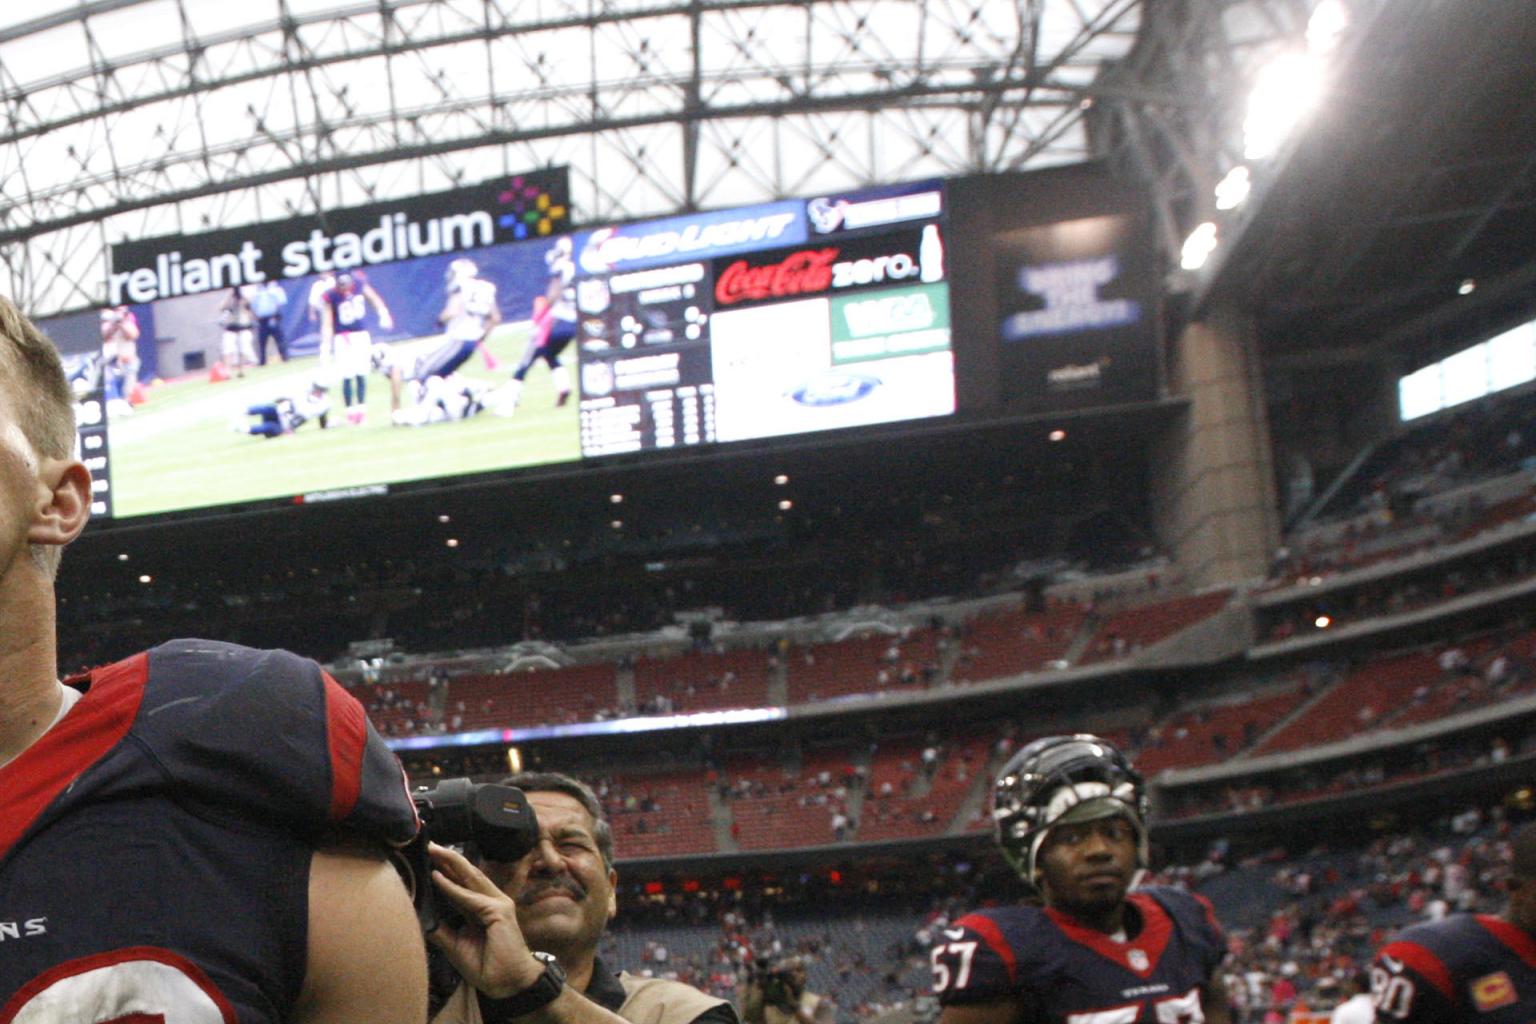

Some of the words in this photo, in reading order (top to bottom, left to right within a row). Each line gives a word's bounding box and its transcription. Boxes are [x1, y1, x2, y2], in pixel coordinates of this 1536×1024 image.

[109, 241, 266, 306] reliant
[282, 209, 494, 278] stadium
[930, 941, 978, 992] 57
